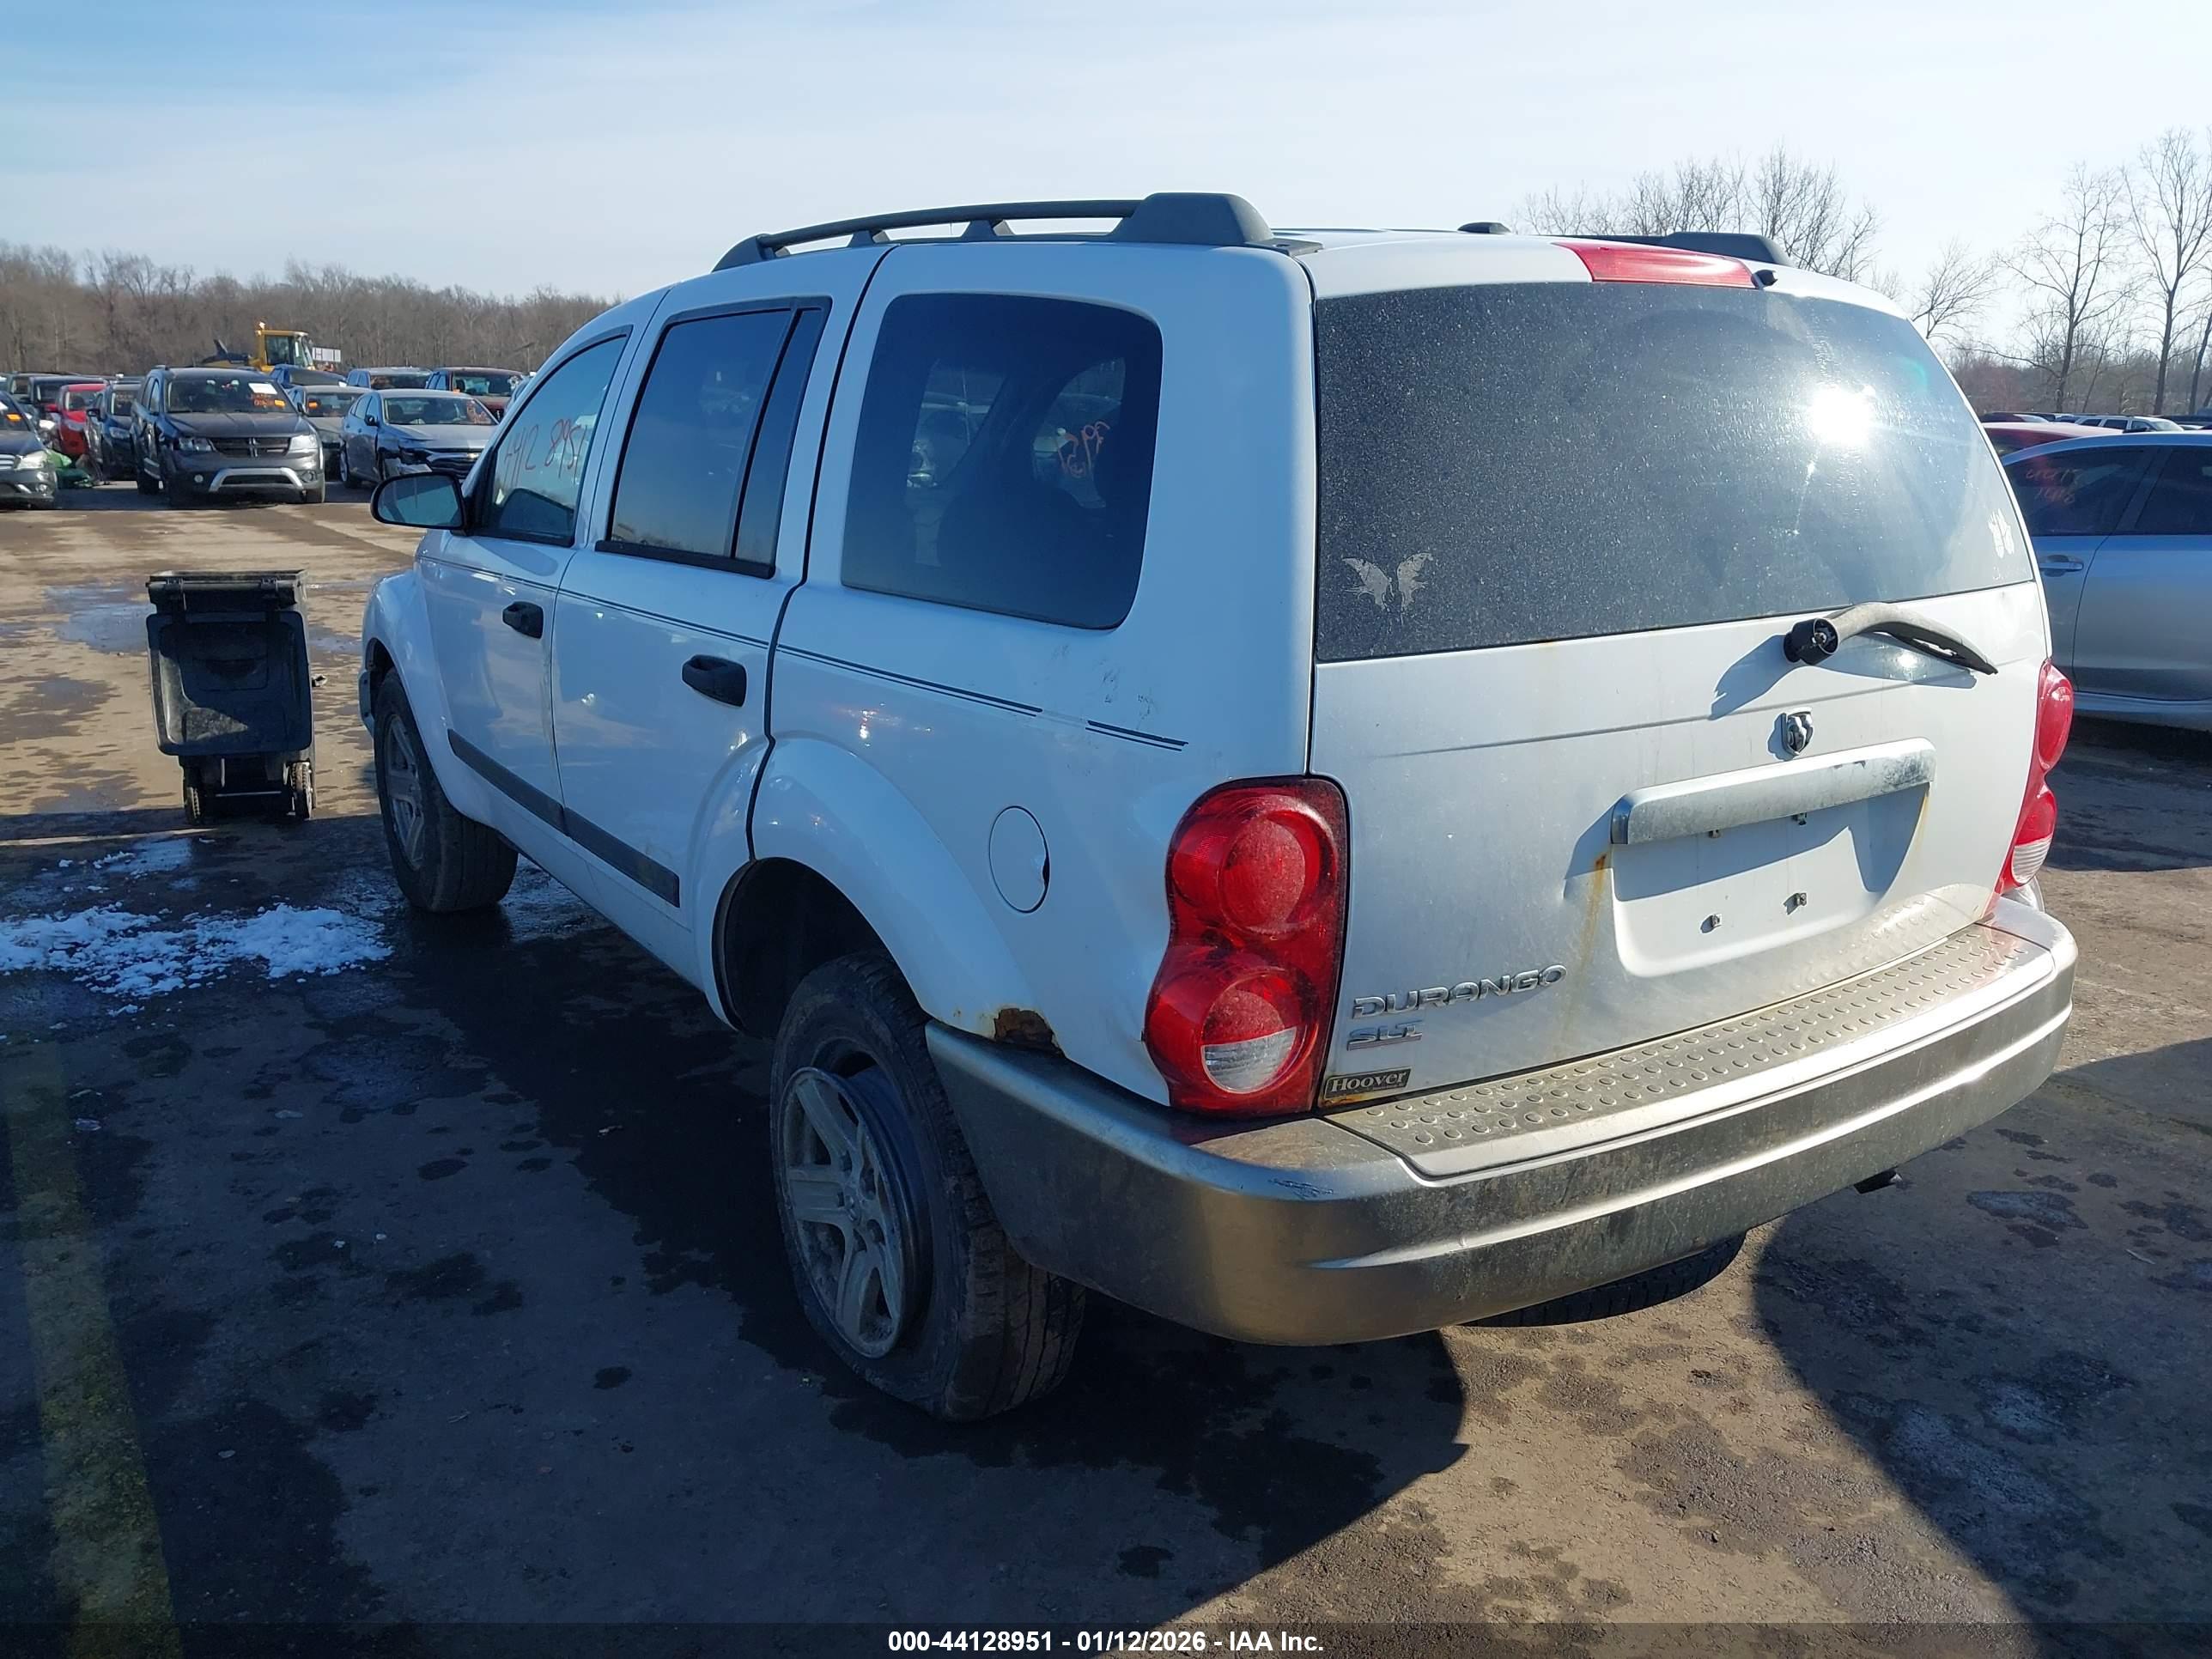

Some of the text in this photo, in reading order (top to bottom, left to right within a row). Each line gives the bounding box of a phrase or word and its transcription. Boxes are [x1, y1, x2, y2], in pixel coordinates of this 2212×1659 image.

[1352, 963, 1568, 1019] DURANGO
[1347, 1020, 1423, 1050] SLT
[1330, 1072, 1407, 1092] Hoover
